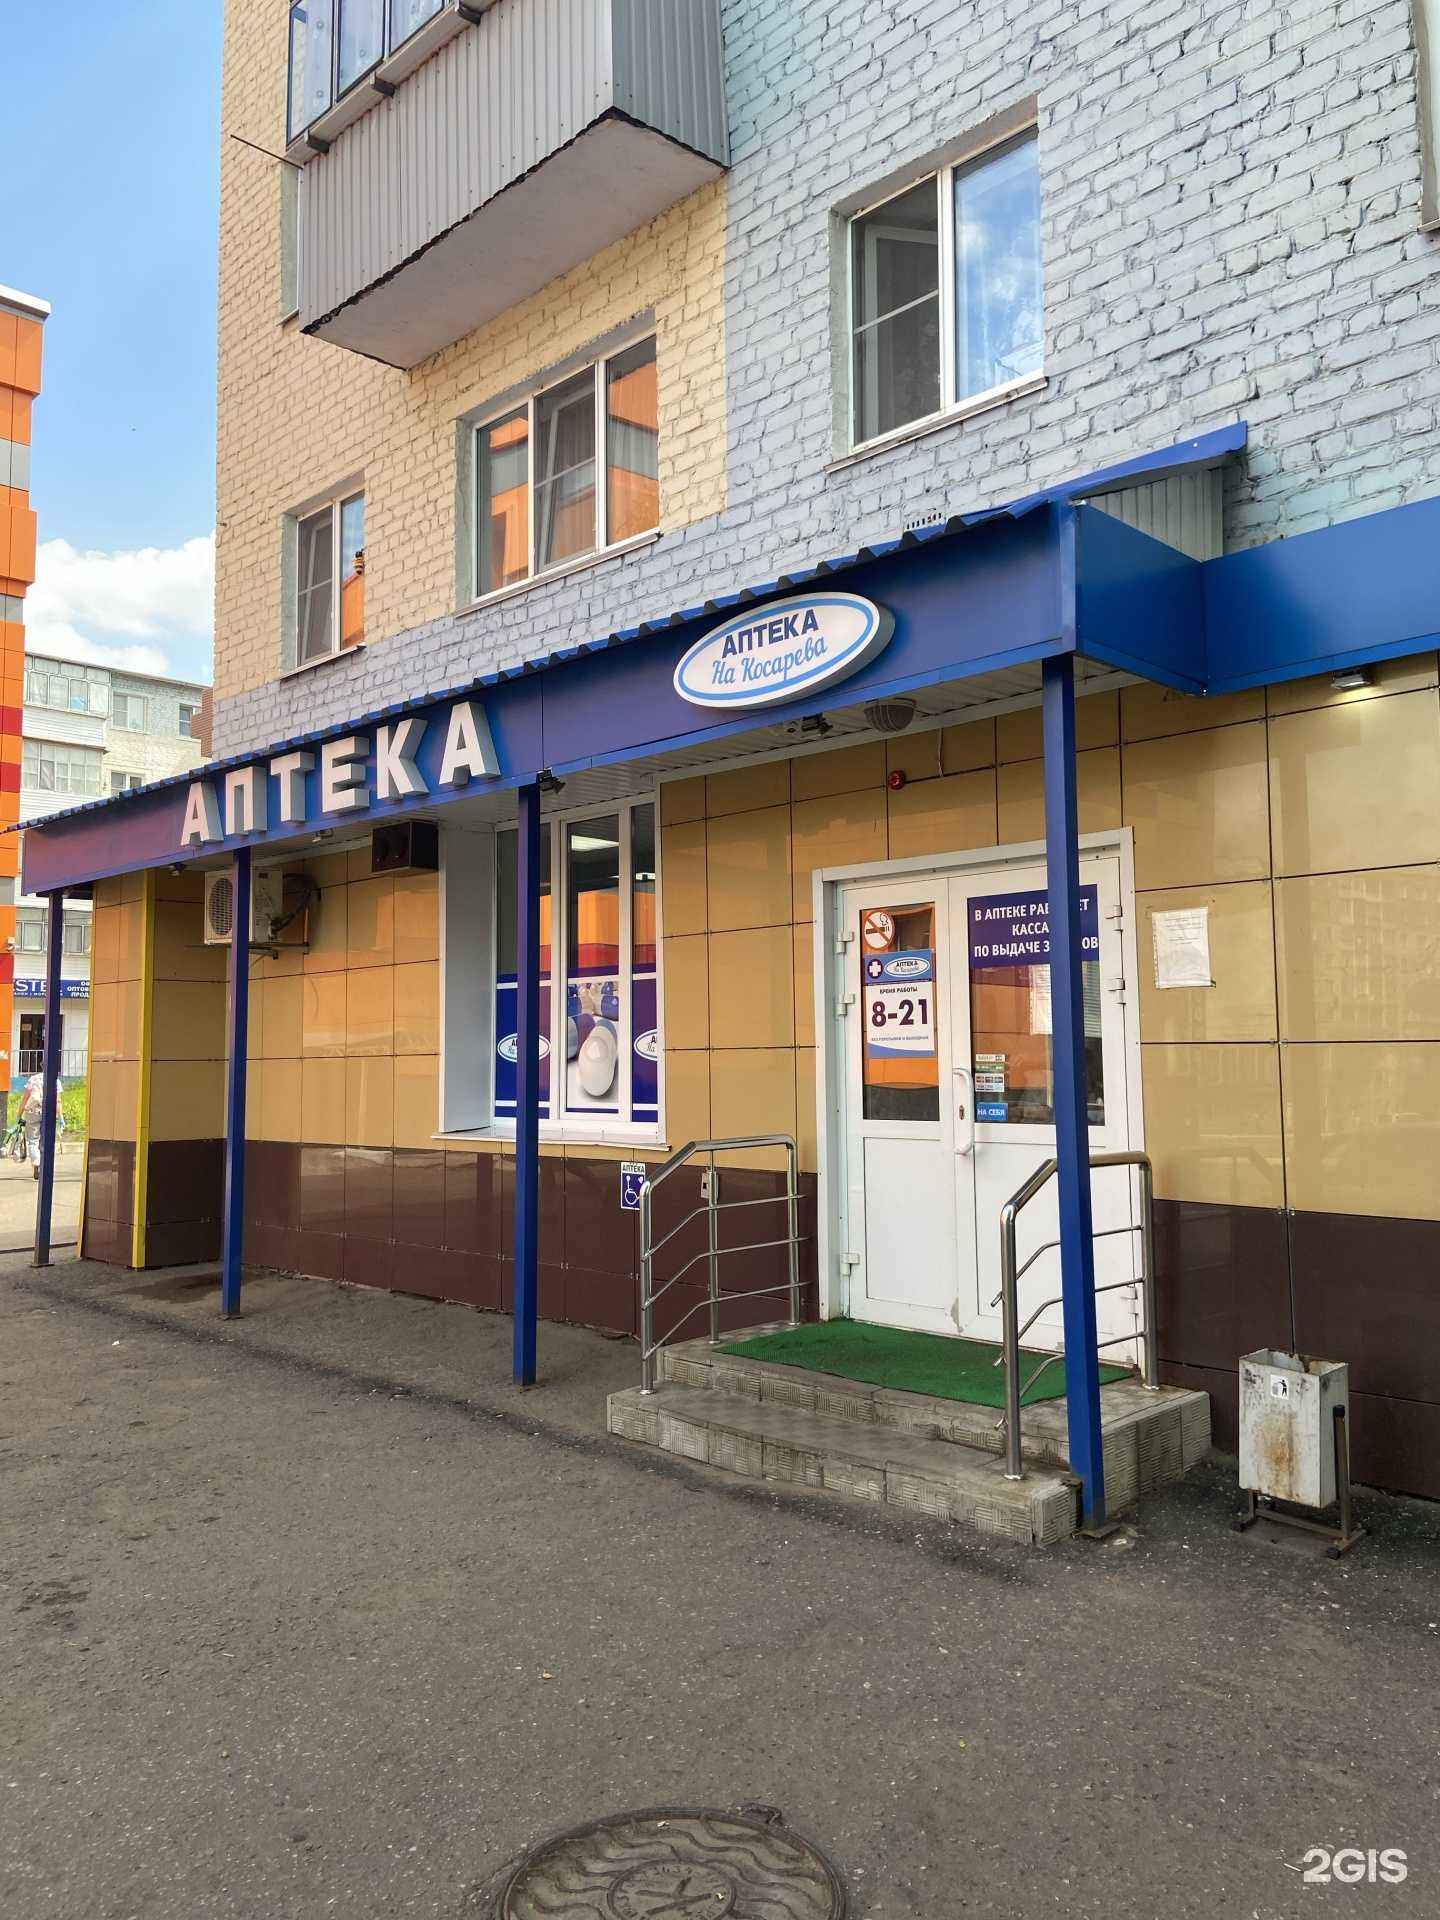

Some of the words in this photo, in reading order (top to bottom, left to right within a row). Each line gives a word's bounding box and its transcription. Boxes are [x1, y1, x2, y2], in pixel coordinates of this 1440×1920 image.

[722, 609, 819, 659] АПТЕКА
[711, 659, 736, 685] На
[742, 636, 828, 683] Косарева
[180, 701, 501, 847] АПТЕКА
[975, 909, 982, 921] В
[985, 905, 1027, 921] АПТЕКЕ
[1012, 921, 1050, 936] КАССА
[974, 945, 990, 958] ПО
[992, 941, 1041, 957] ВЫДАЧЕ
[872, 999, 928, 1028] 8-21
